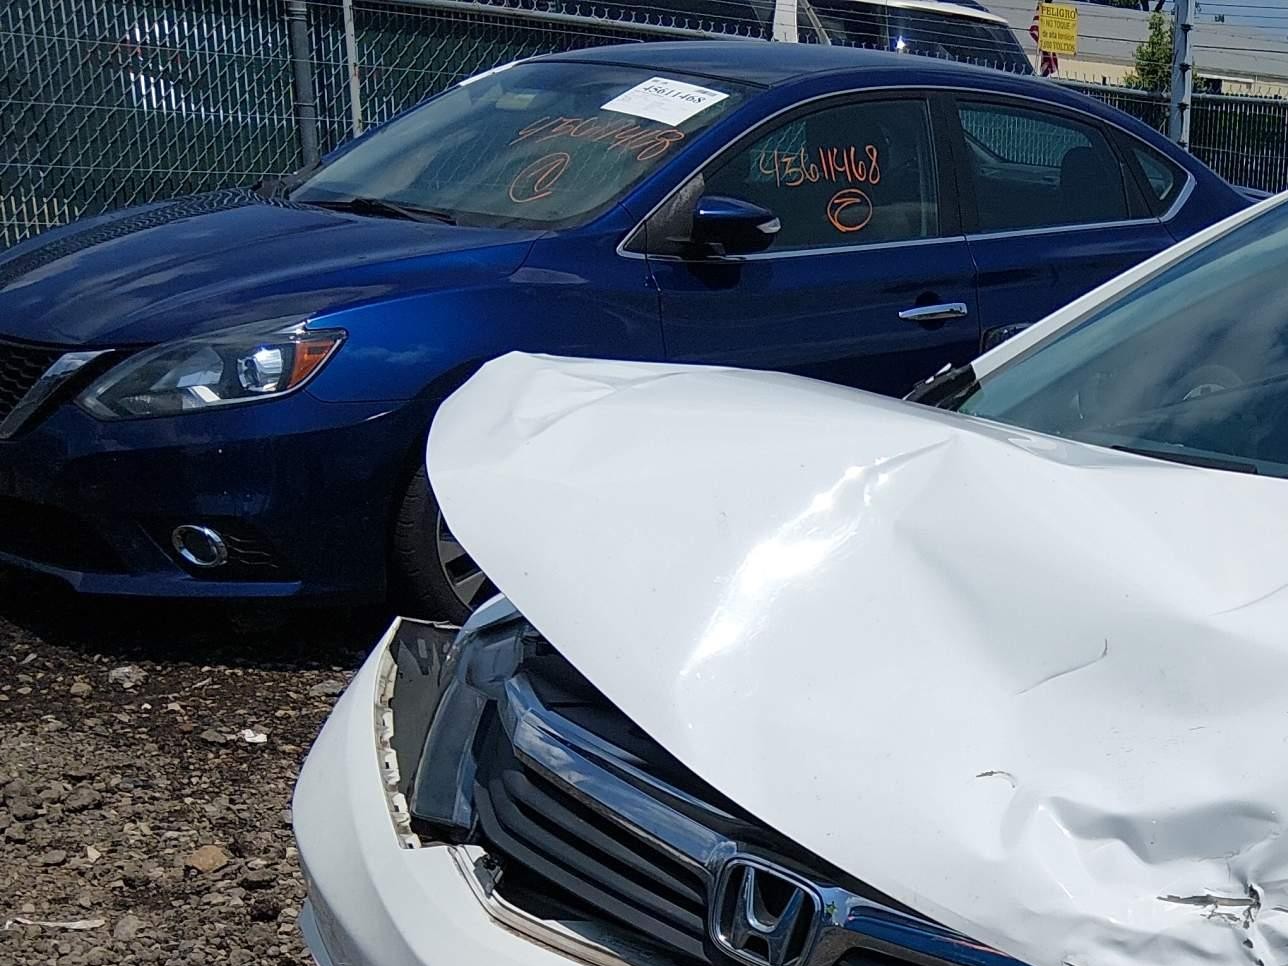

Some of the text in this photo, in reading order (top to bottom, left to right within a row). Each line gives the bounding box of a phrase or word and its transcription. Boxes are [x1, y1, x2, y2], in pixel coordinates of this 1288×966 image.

[1041, 6, 1076, 19] PELIGRO
[643, 85, 706, 104] 45611468
[759, 144, 881, 188] 45611468
